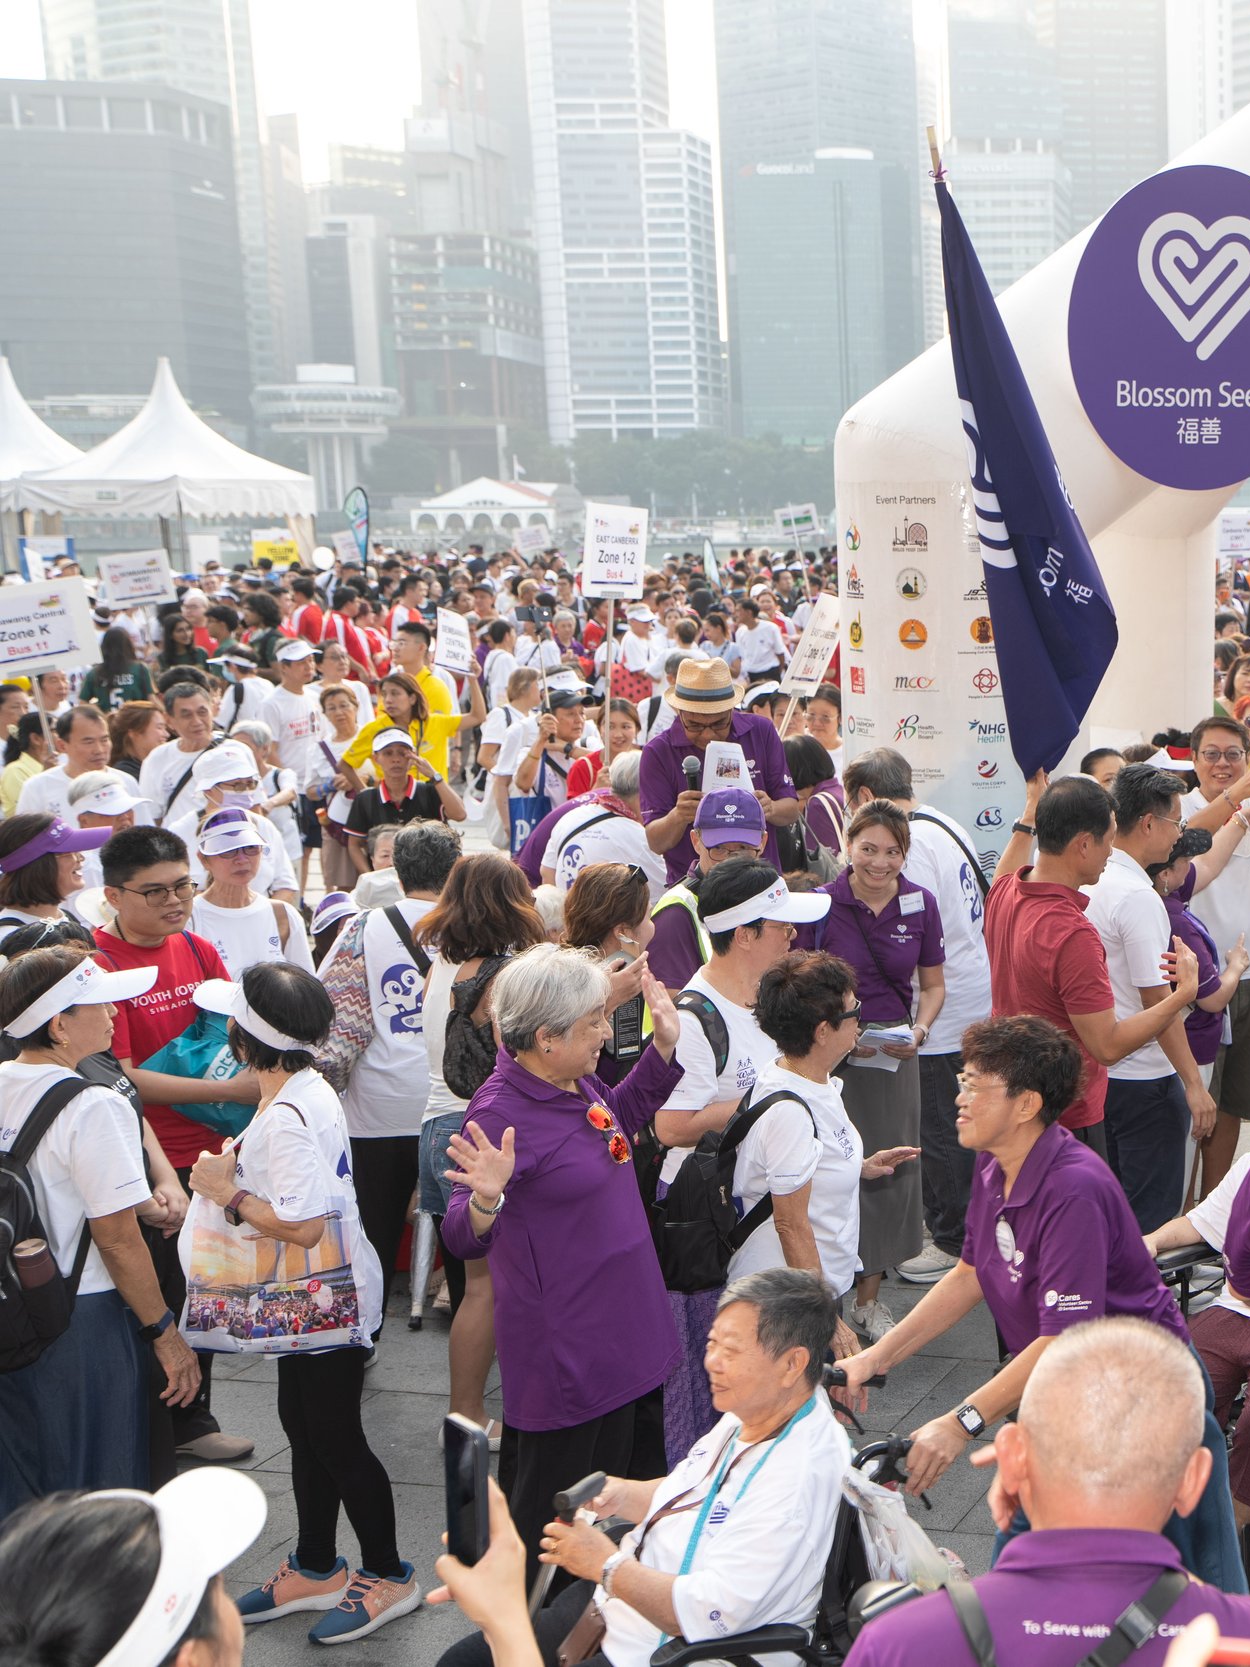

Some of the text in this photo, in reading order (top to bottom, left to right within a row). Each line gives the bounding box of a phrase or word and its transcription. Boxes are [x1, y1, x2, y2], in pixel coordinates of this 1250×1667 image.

[1116, 380, 1212, 407] Blossom
[1176, 417, 1222, 444] 福善
[875, 495, 937, 505] Event Partners
[598, 550, 636, 564] Zone 1-2
[606, 569, 618, 579] Bus
[0, 624, 51, 643] Zone K
[7, 645, 33, 656] Bus
[978, 723, 1006, 736] NHG
[977, 734, 1005, 744] Health
[129, 990, 172, 1008] YOUTH
[1059, 1294, 1081, 1302] Cares
[1022, 1620, 1041, 1635] To
[1042, 1621, 1081, 1637] Serve
[1082, 1624, 1111, 1638] with
